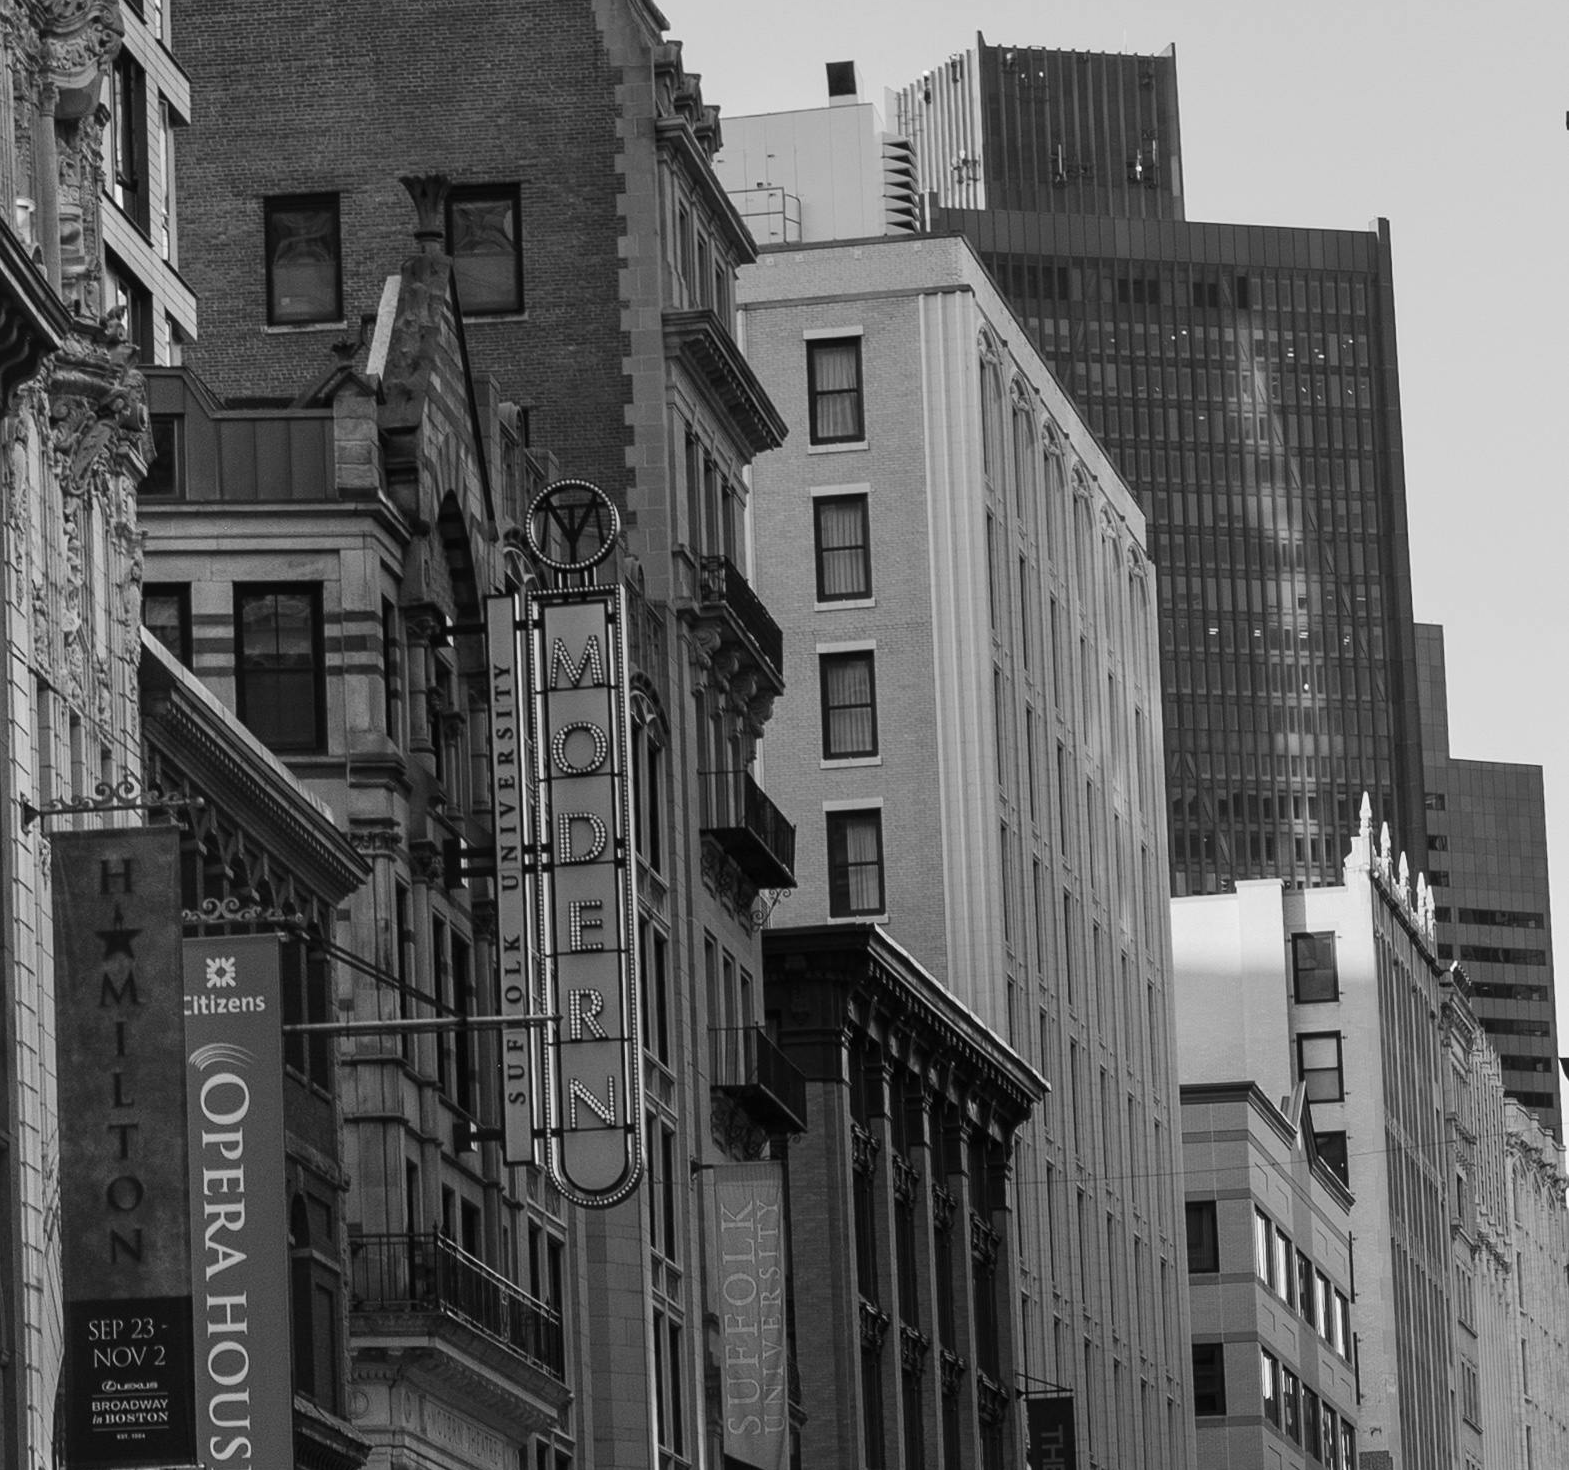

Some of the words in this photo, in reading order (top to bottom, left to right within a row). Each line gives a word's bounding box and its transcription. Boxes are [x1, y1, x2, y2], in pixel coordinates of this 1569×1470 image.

[493, 663, 519, 891] UNIVERSITY
[551, 634, 616, 1132] MODERN
[504, 933, 526, 1106] SUFOLK
[200, 1072, 252, 1283] OPERA
[88, 1319, 124, 1341] SEP
[130, 1317, 155, 1339] 23
[93, 1346, 147, 1369] NOV
[153, 1345, 166, 1366] 2
[116, 1381, 159, 1391] LEXUS
[720, 1199, 762, 1435] SUFFOLK
[759, 1200, 786, 1436] UNIVERSITY
[91, 1398, 169, 1412] BROADWAY
[92, 1414, 103, 1425] in
[105, 1411, 169, 1425] BOSTON
